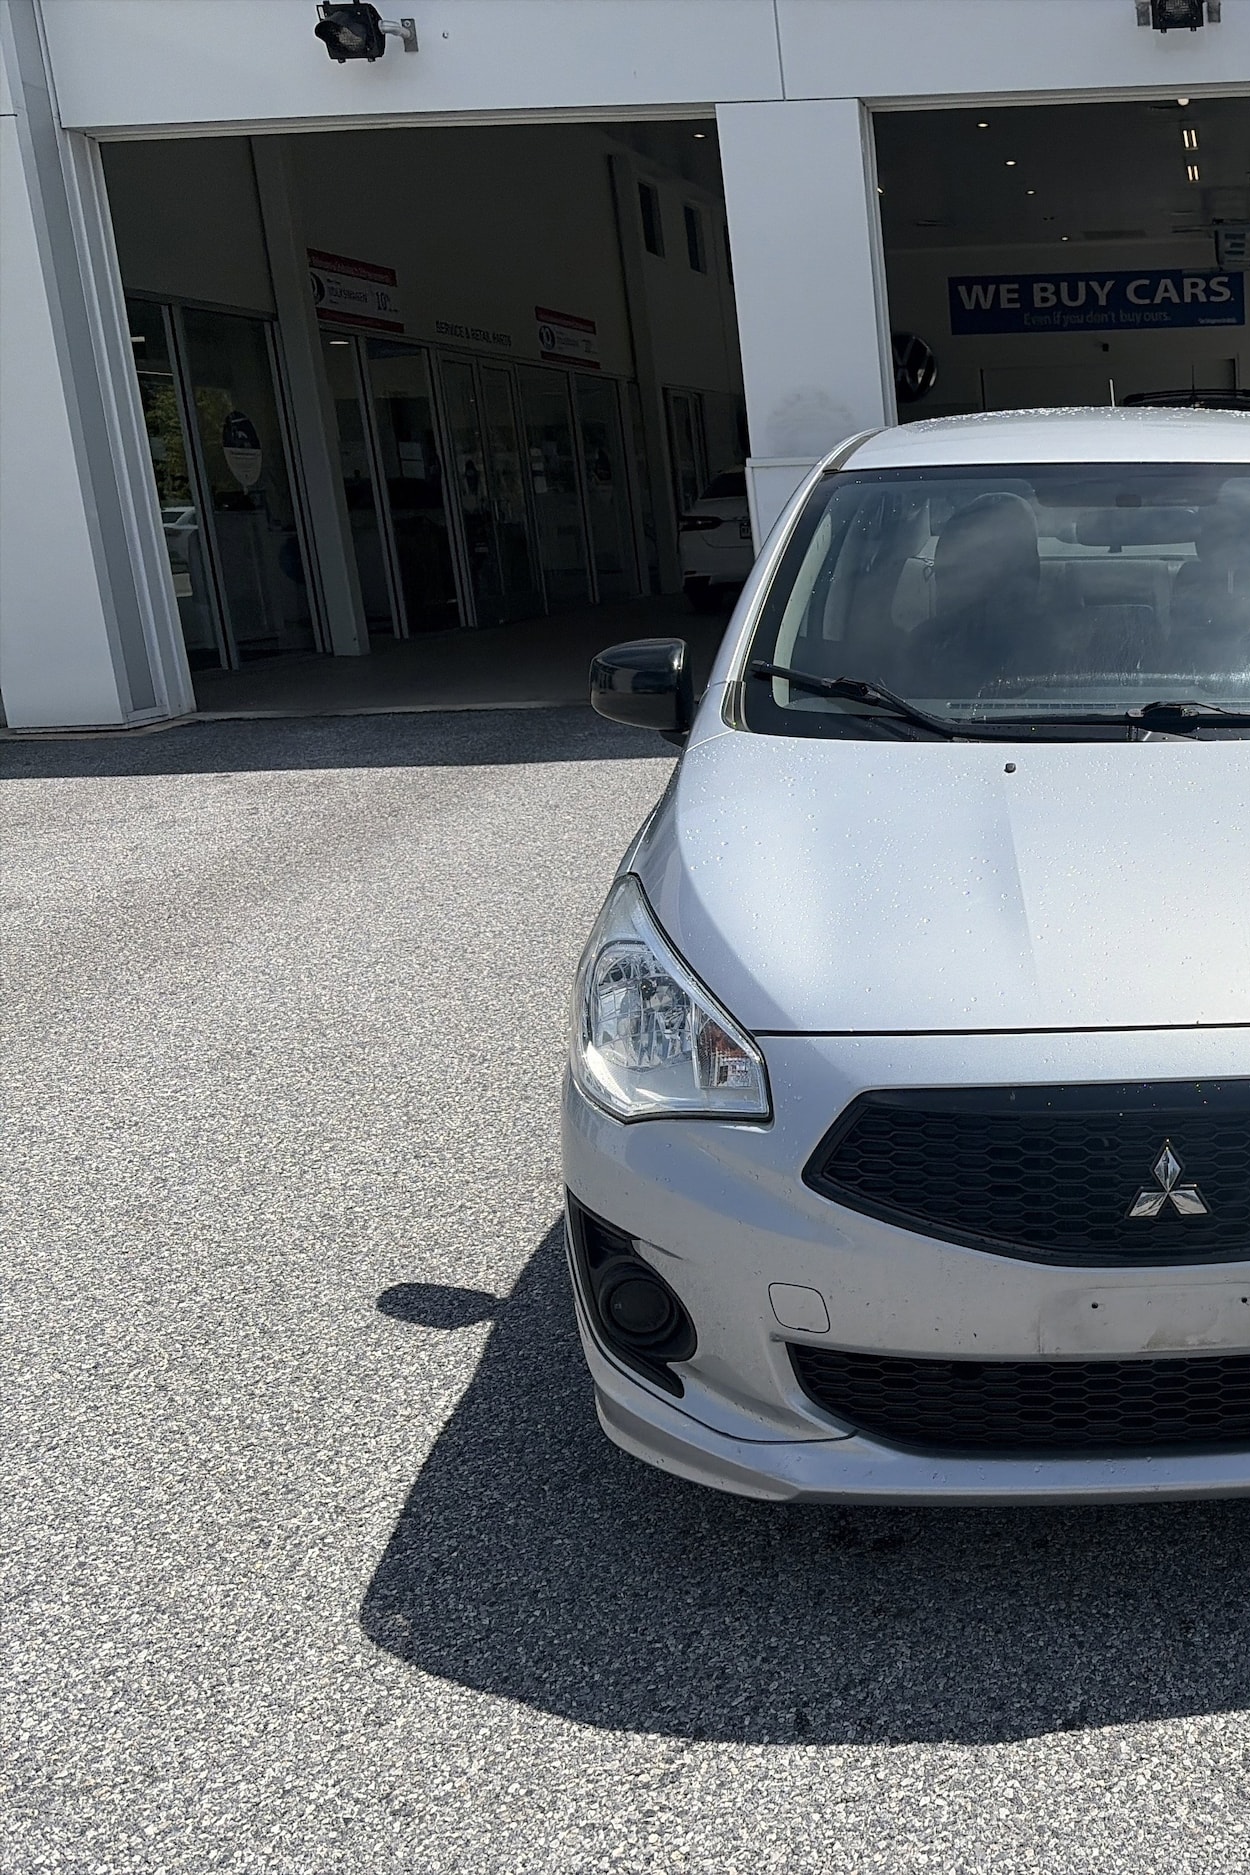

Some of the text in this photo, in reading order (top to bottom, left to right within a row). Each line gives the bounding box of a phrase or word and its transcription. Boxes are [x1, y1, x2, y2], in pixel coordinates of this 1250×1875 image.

[957, 283, 1021, 310] WE
[1032, 281, 1116, 308] BUY
[1023, 313, 1051, 326] Even
[1052, 311, 1062, 325] if
[1061, 313, 1084, 327] you
[1085, 310, 1115, 325] don't
[1119, 309, 1142, 324] buy
